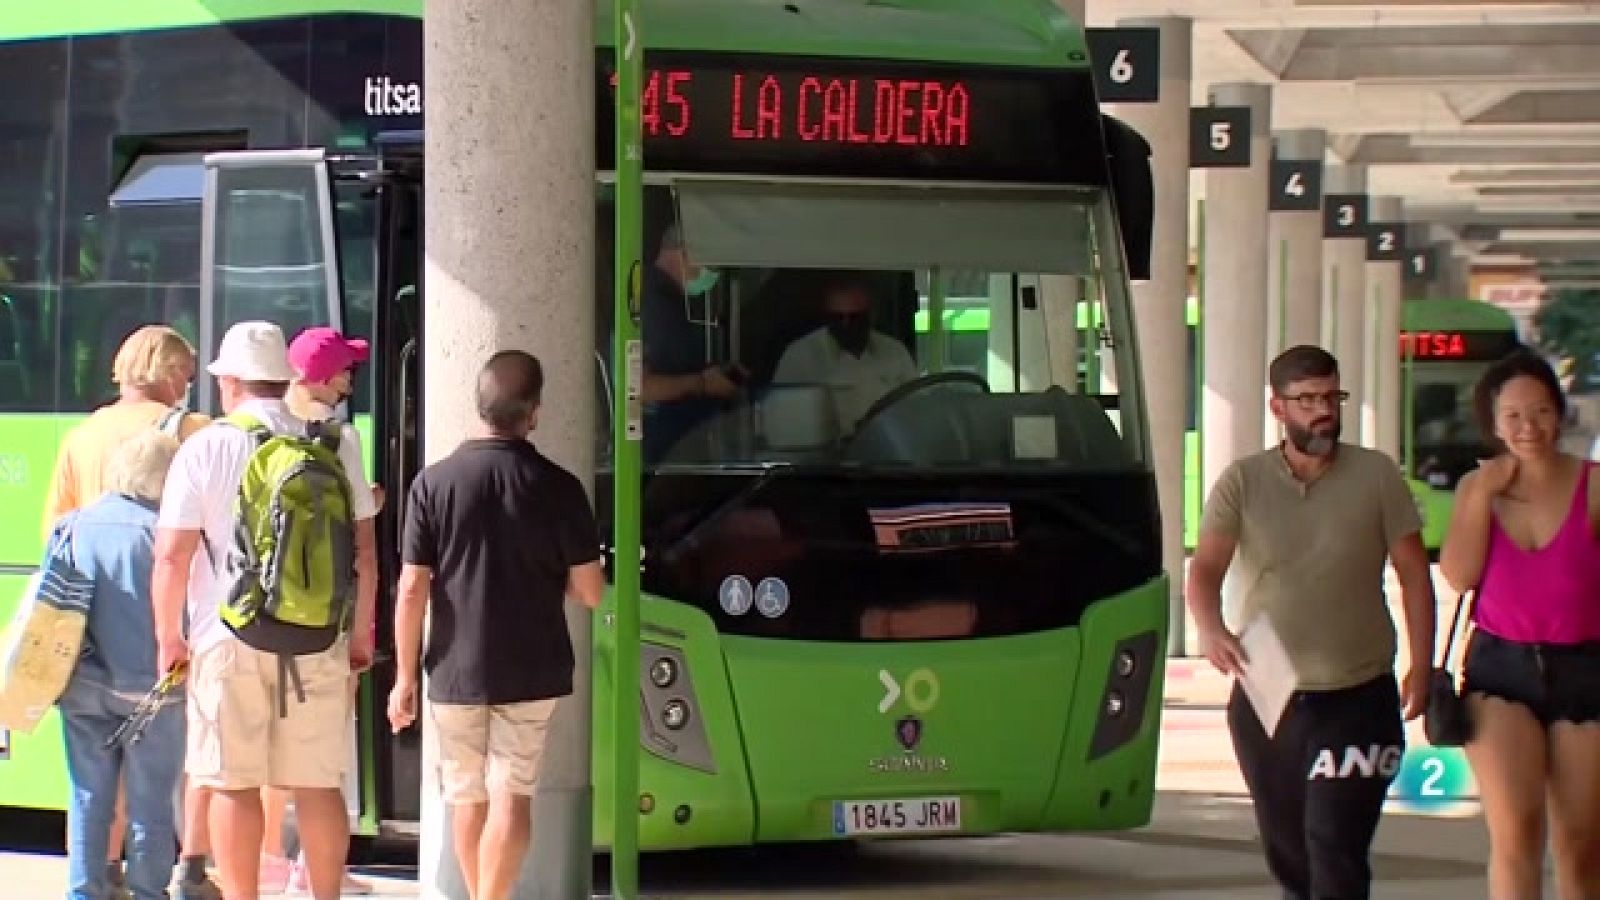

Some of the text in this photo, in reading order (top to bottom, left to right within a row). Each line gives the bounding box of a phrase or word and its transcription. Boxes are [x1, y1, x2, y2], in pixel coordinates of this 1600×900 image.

[1110, 49, 1133, 83] 6
[364, 76, 421, 116] titsa
[731, 74, 782, 139] LA
[799, 76, 969, 146] CALDERA
[1209, 122, 1231, 151] 5
[1284, 172, 1305, 196] 4
[1338, 204, 1355, 226] 3
[1377, 231, 1395, 251] 2
[1412, 254, 1425, 273] 1
[852, 801, 956, 829] 1845 JRM
